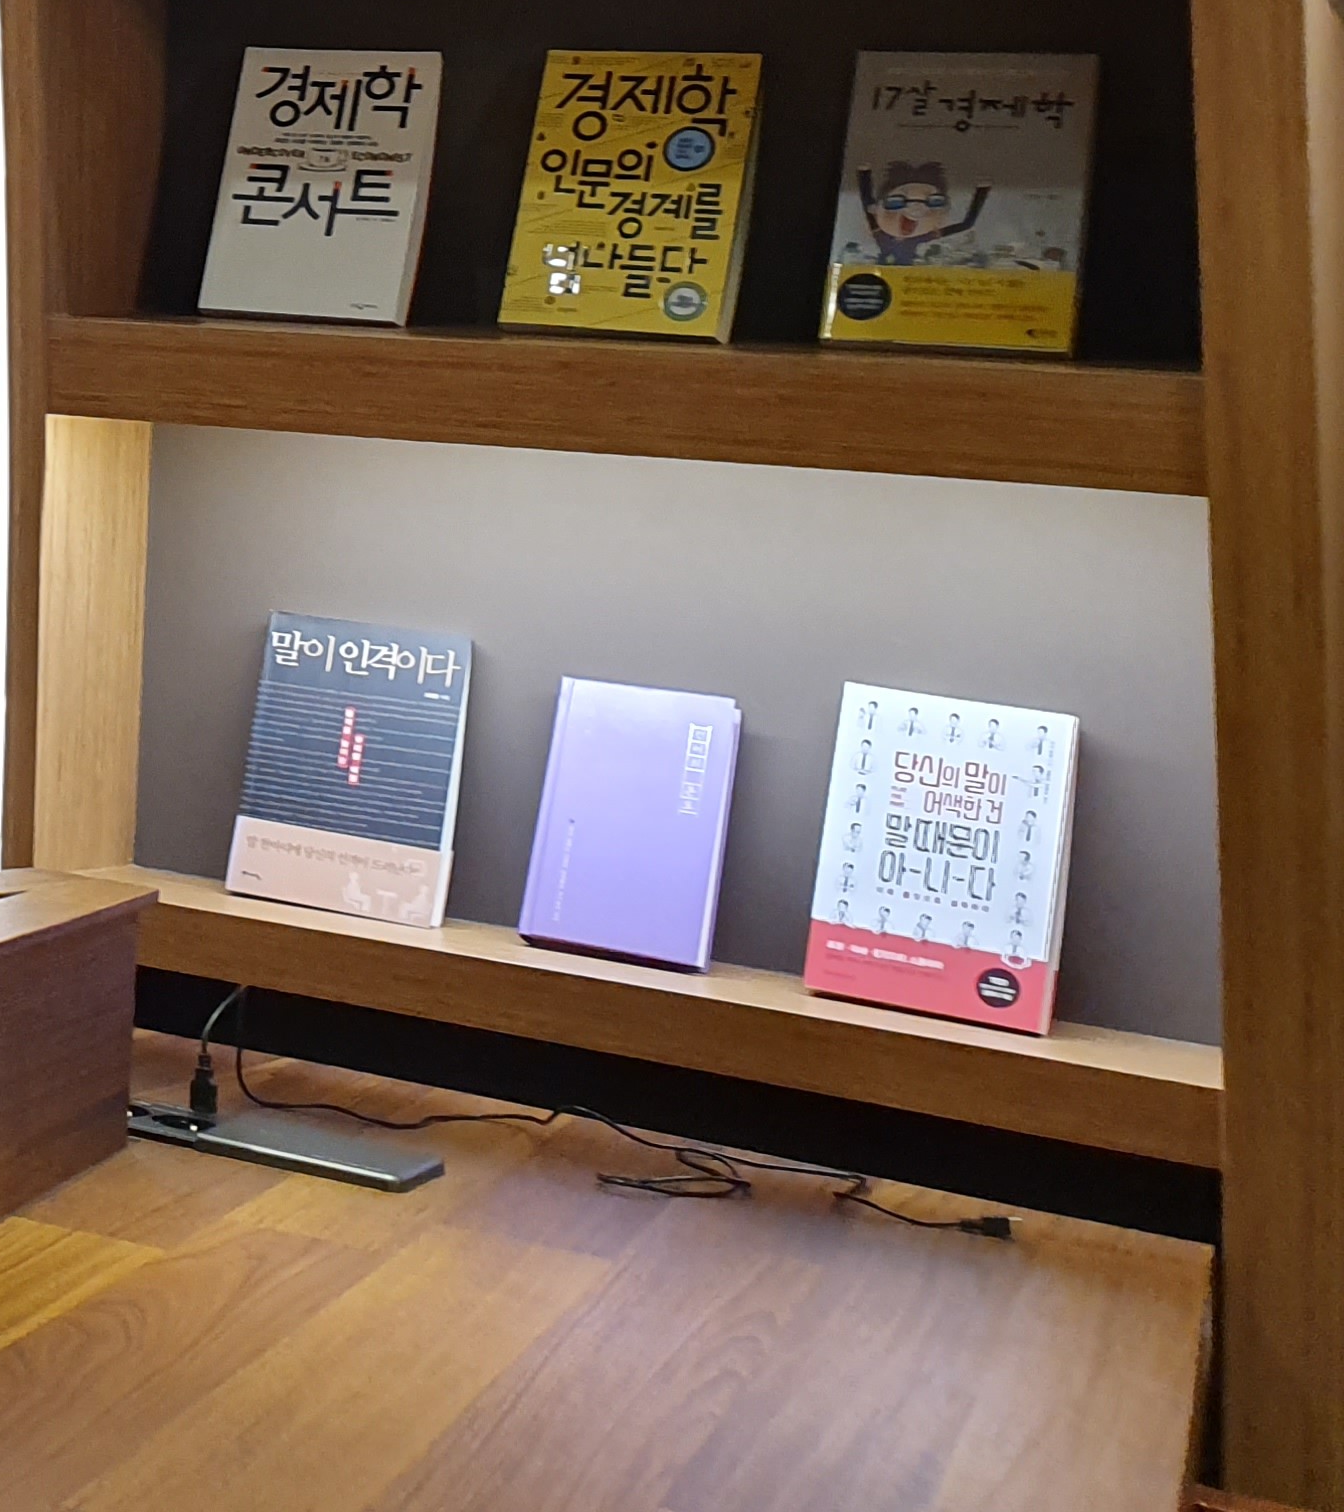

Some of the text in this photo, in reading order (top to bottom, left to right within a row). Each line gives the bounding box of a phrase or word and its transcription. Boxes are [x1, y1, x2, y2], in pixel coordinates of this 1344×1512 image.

[256, 65, 423, 131] 경제학
[556, 63, 737, 141] 경제학
[232, 163, 399, 236] 콘서트
[540, 148, 654, 209] 인문의
[607, 183, 723, 240] 경계를
[271, 630, 462, 688] 말이 인격이다
[894, 750, 1007, 796] 당신의 말이
